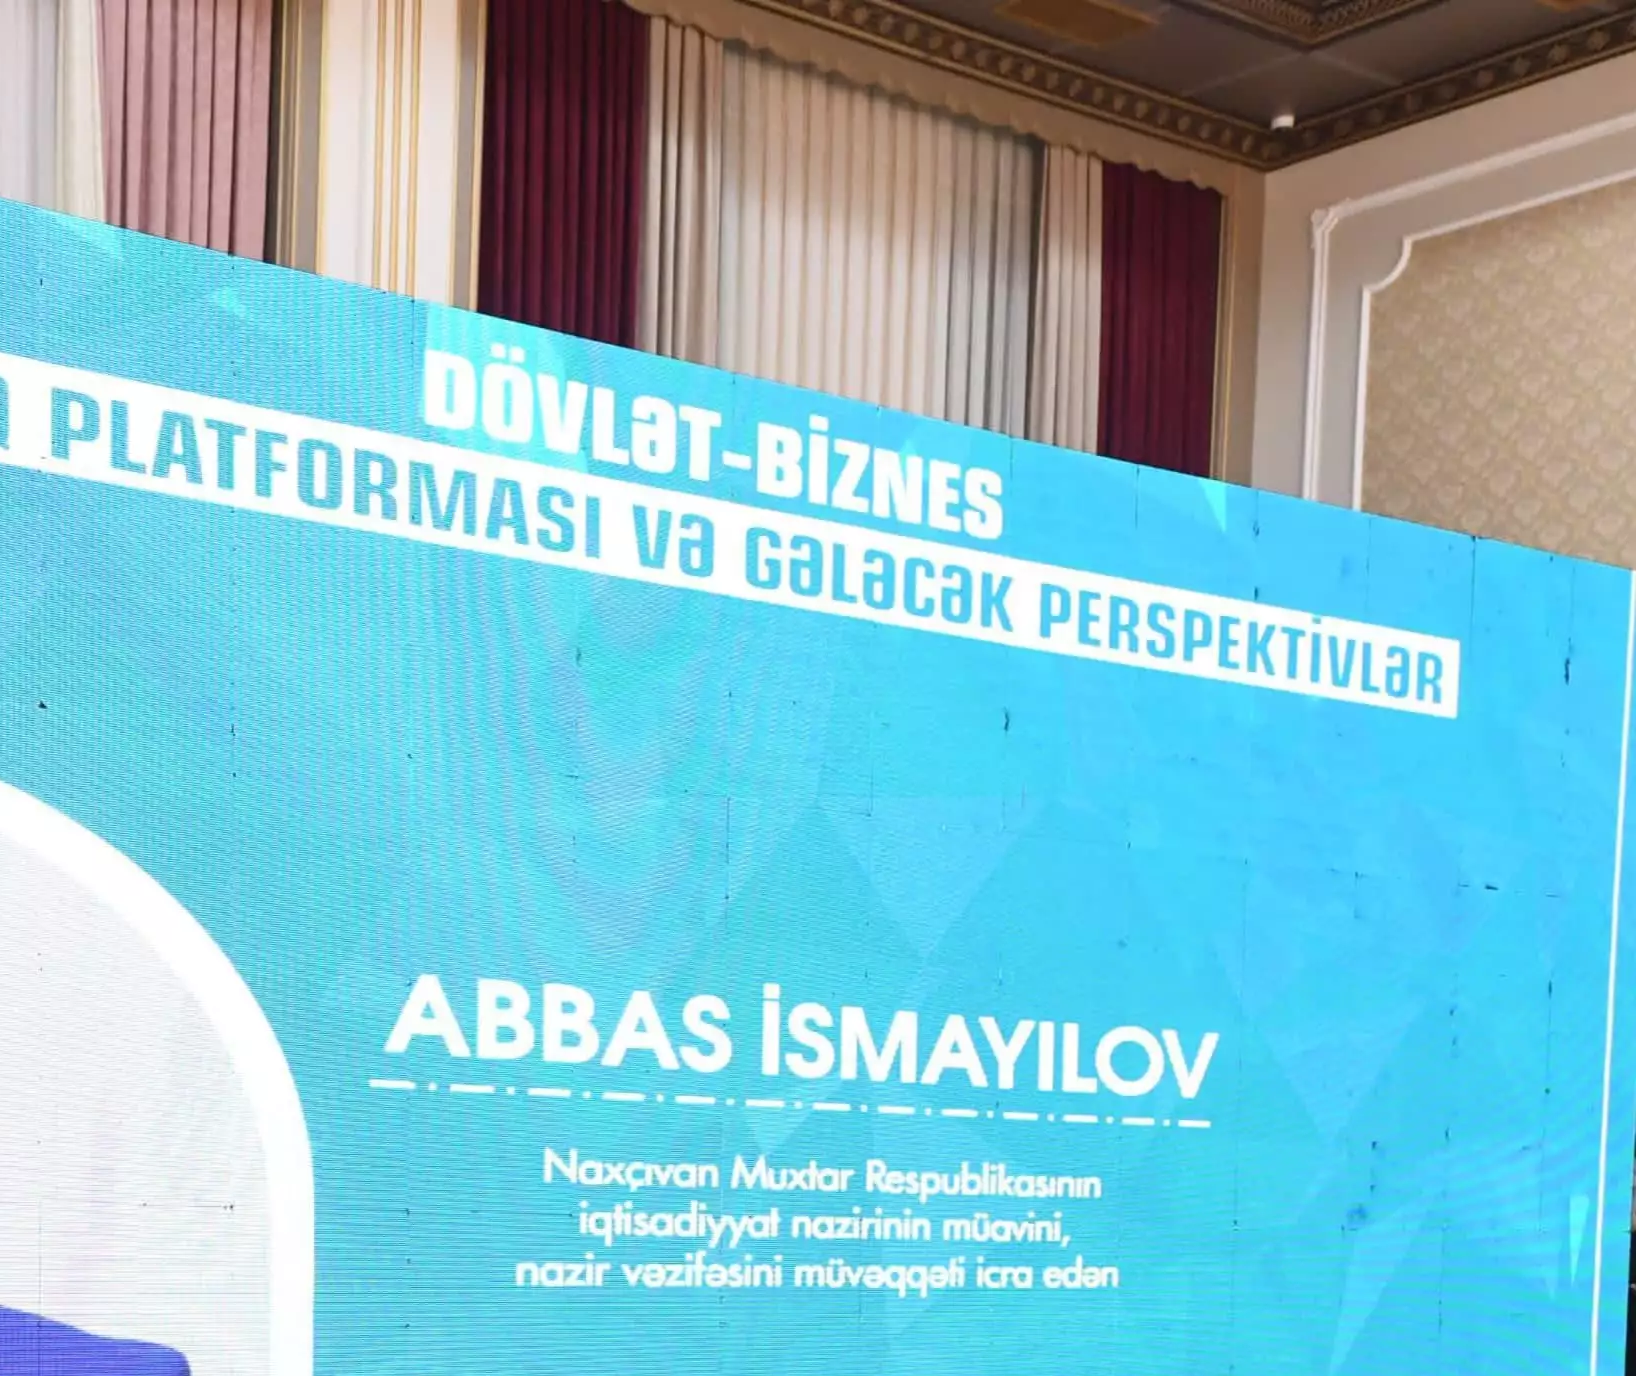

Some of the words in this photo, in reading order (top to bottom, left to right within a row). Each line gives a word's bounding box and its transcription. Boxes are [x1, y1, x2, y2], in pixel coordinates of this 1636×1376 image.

[50, 386, 601, 558] PLATFORMASI
[384, 973, 733, 1074] ABBAS
[762, 983, 1220, 1100] İSMAYILOV
[542, 1147, 719, 1192] Naxçıvan
[730, 1155, 855, 1192] Muxtar
[865, 1159, 1102, 1204] Respublikasının
[578, 1200, 781, 1248] iqtisadiyyat
[791, 1206, 931, 1241] nazirinin
[942, 1211, 1071, 1248] müavini,
[515, 1252, 612, 1287] nazir
[621, 1250, 783, 1288] vəzifəsini
[794, 1256, 965, 1298] müvəqqəti
[976, 1256, 1033, 1288] icra
[1042, 1254, 1119, 1289] edən
